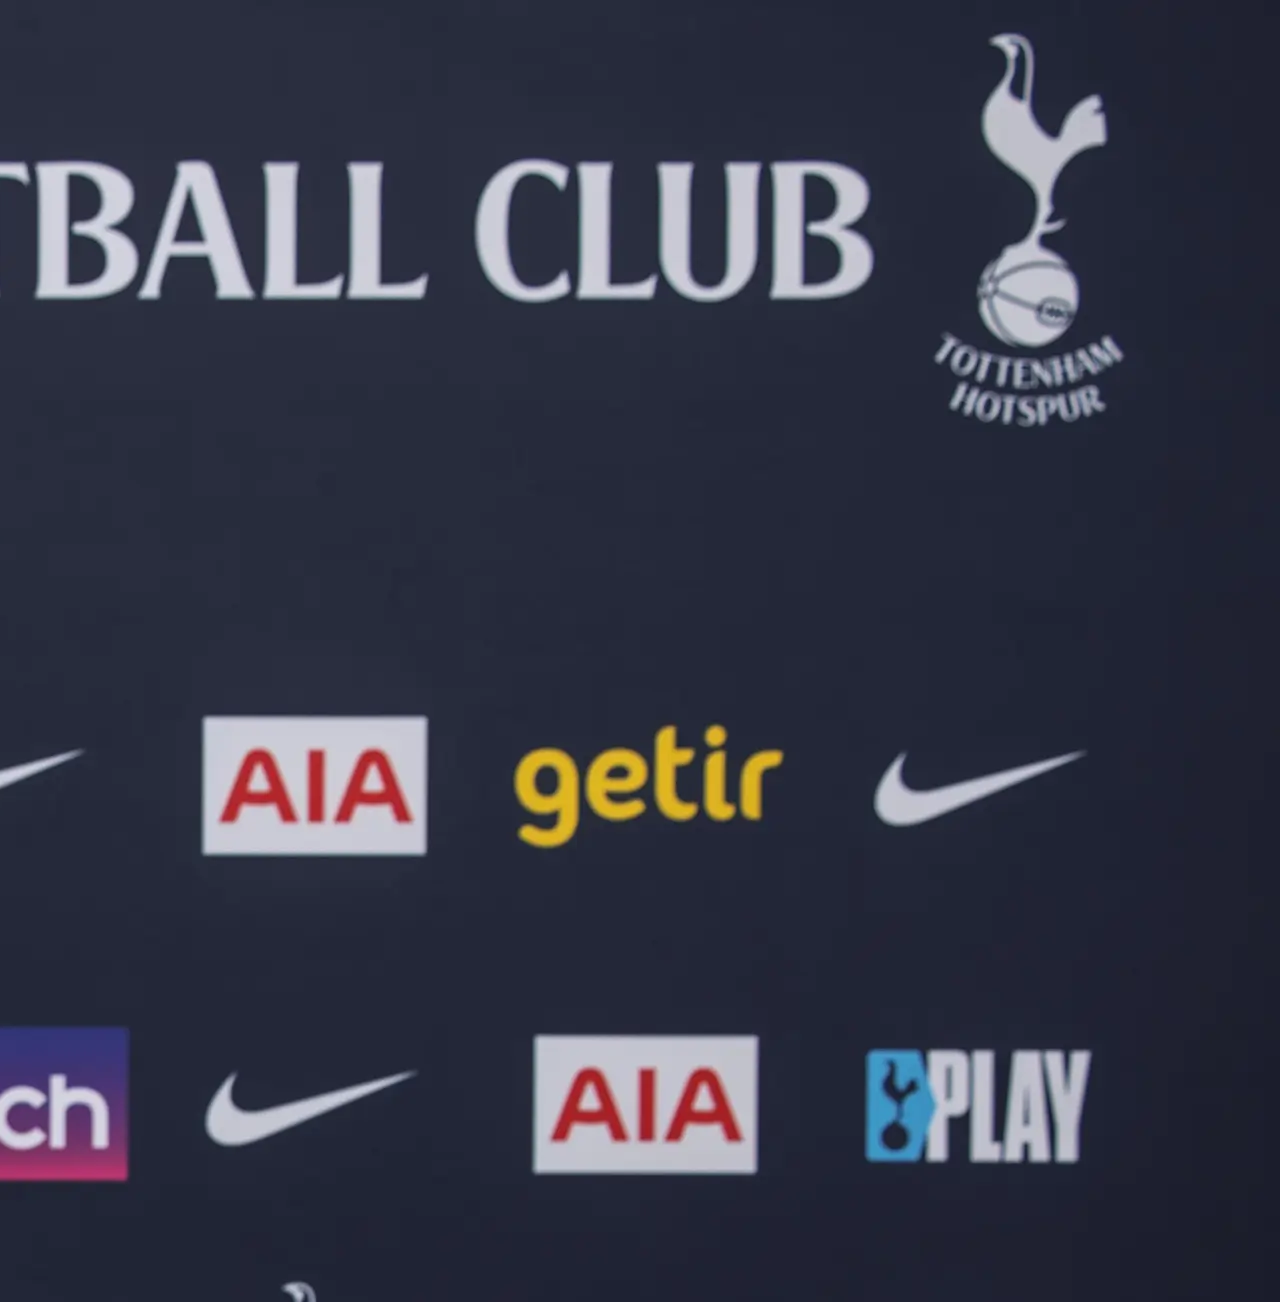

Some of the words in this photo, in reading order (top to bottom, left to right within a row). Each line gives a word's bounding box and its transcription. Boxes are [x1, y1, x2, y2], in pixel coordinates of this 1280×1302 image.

[474, 157, 875, 304] CLUB
[934, 332, 1124, 390] TOTTENHAM
[949, 381, 1106, 428] HOTSPUR
[220, 748, 413, 824] AIA
[514, 725, 783, 848] getir
[551, 1067, 742, 1143] AIA
[925, 1048, 1092, 1164] PLAY
